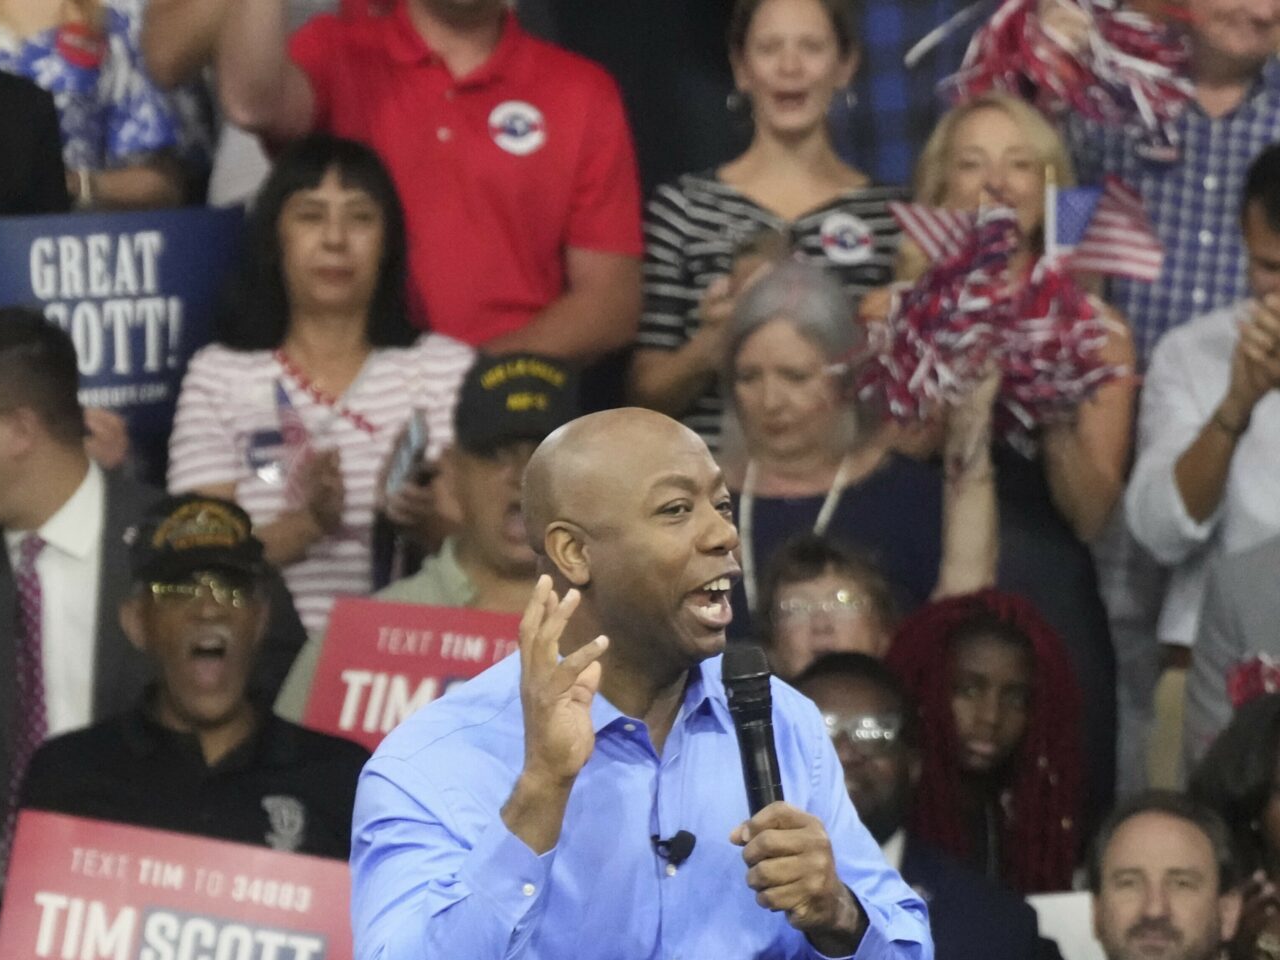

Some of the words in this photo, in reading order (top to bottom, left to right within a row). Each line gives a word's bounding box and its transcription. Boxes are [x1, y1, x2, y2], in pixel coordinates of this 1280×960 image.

[30, 230, 164, 300] GREAT
[43, 296, 182, 377] OTT!
[377, 626, 433, 656] TEXT
[440, 631, 486, 663] TIM
[337, 668, 438, 735] TIM
[71, 847, 128, 879] TEXT
[138, 857, 185, 890] TIM
[194, 867, 224, 897] TO
